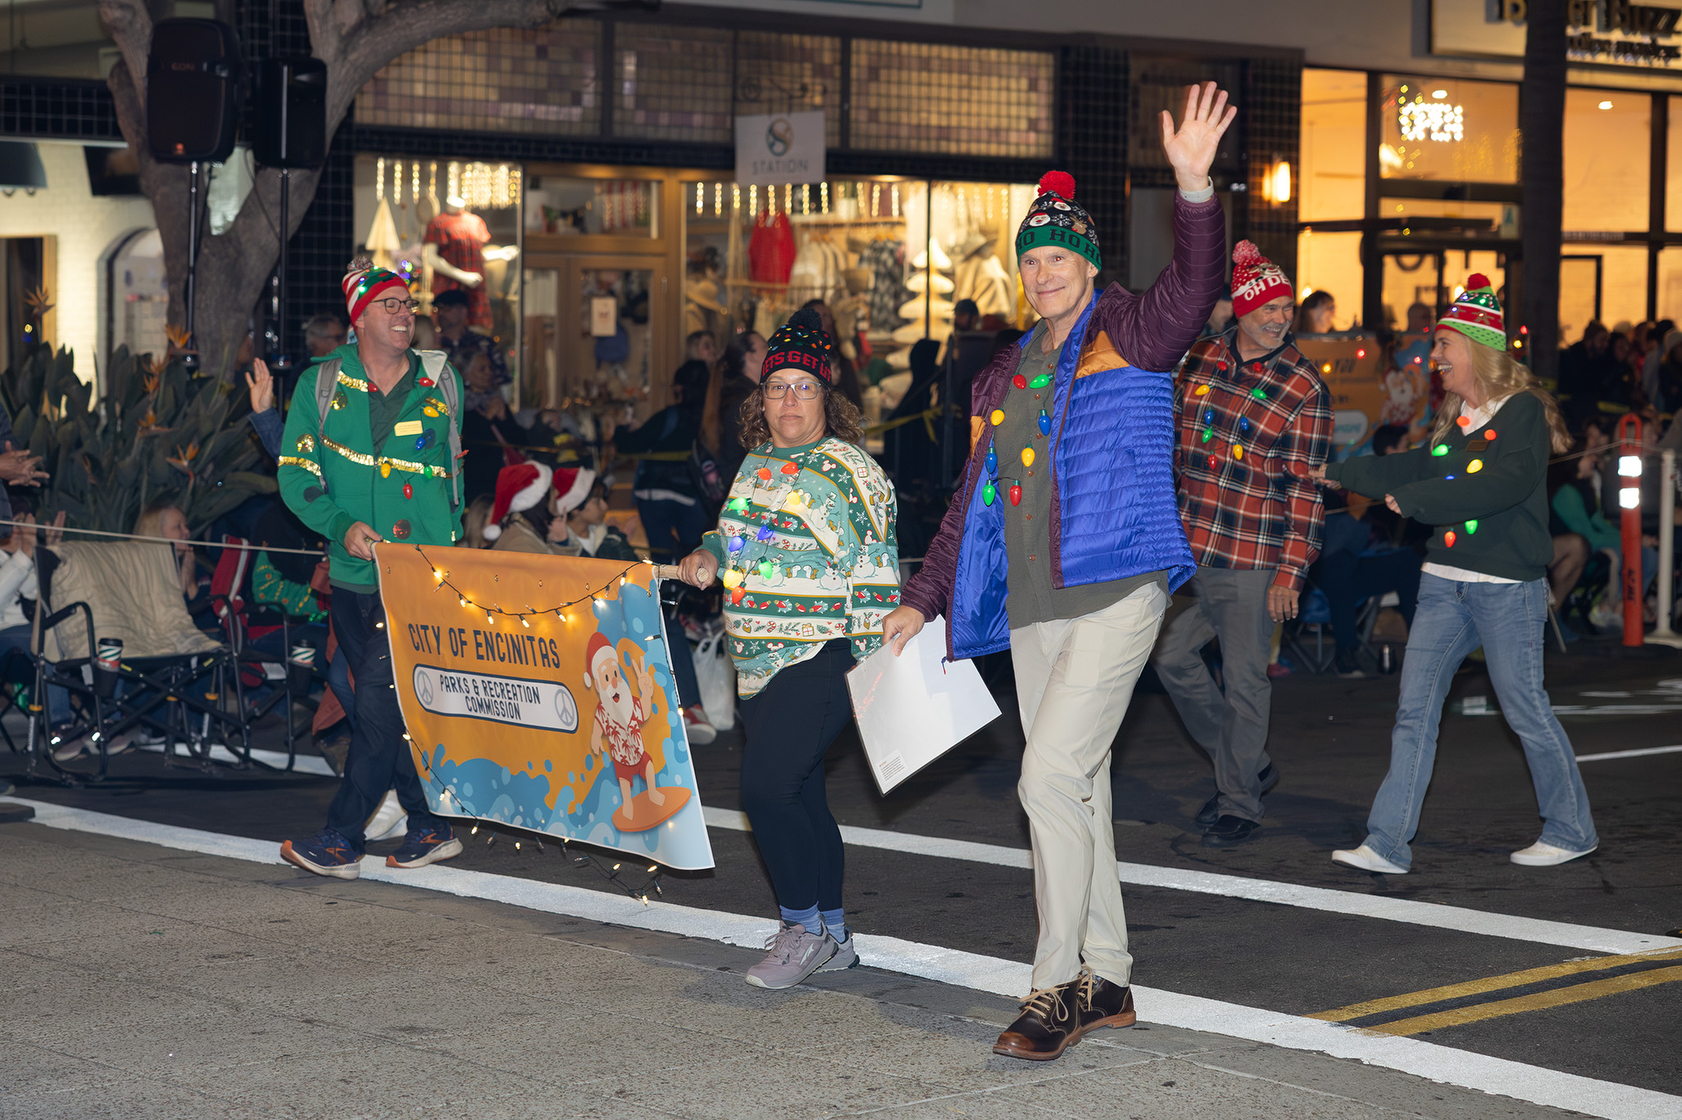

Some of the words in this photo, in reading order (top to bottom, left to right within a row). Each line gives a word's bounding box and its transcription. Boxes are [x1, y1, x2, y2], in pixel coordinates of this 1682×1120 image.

[752, 159, 808, 175] STATION
[1244, 284, 1266, 301] OH
[787, 350, 819, 369] GET
[408, 623, 441, 655] CITY
[449, 627, 468, 658] OF
[473, 629, 561, 669] ENCINITAS
[440, 674, 470, 694] PARKS
[472, 679, 480, 696] &
[482, 679, 541, 704] RECREATION
[465, 696, 521, 720] COMMISSION
